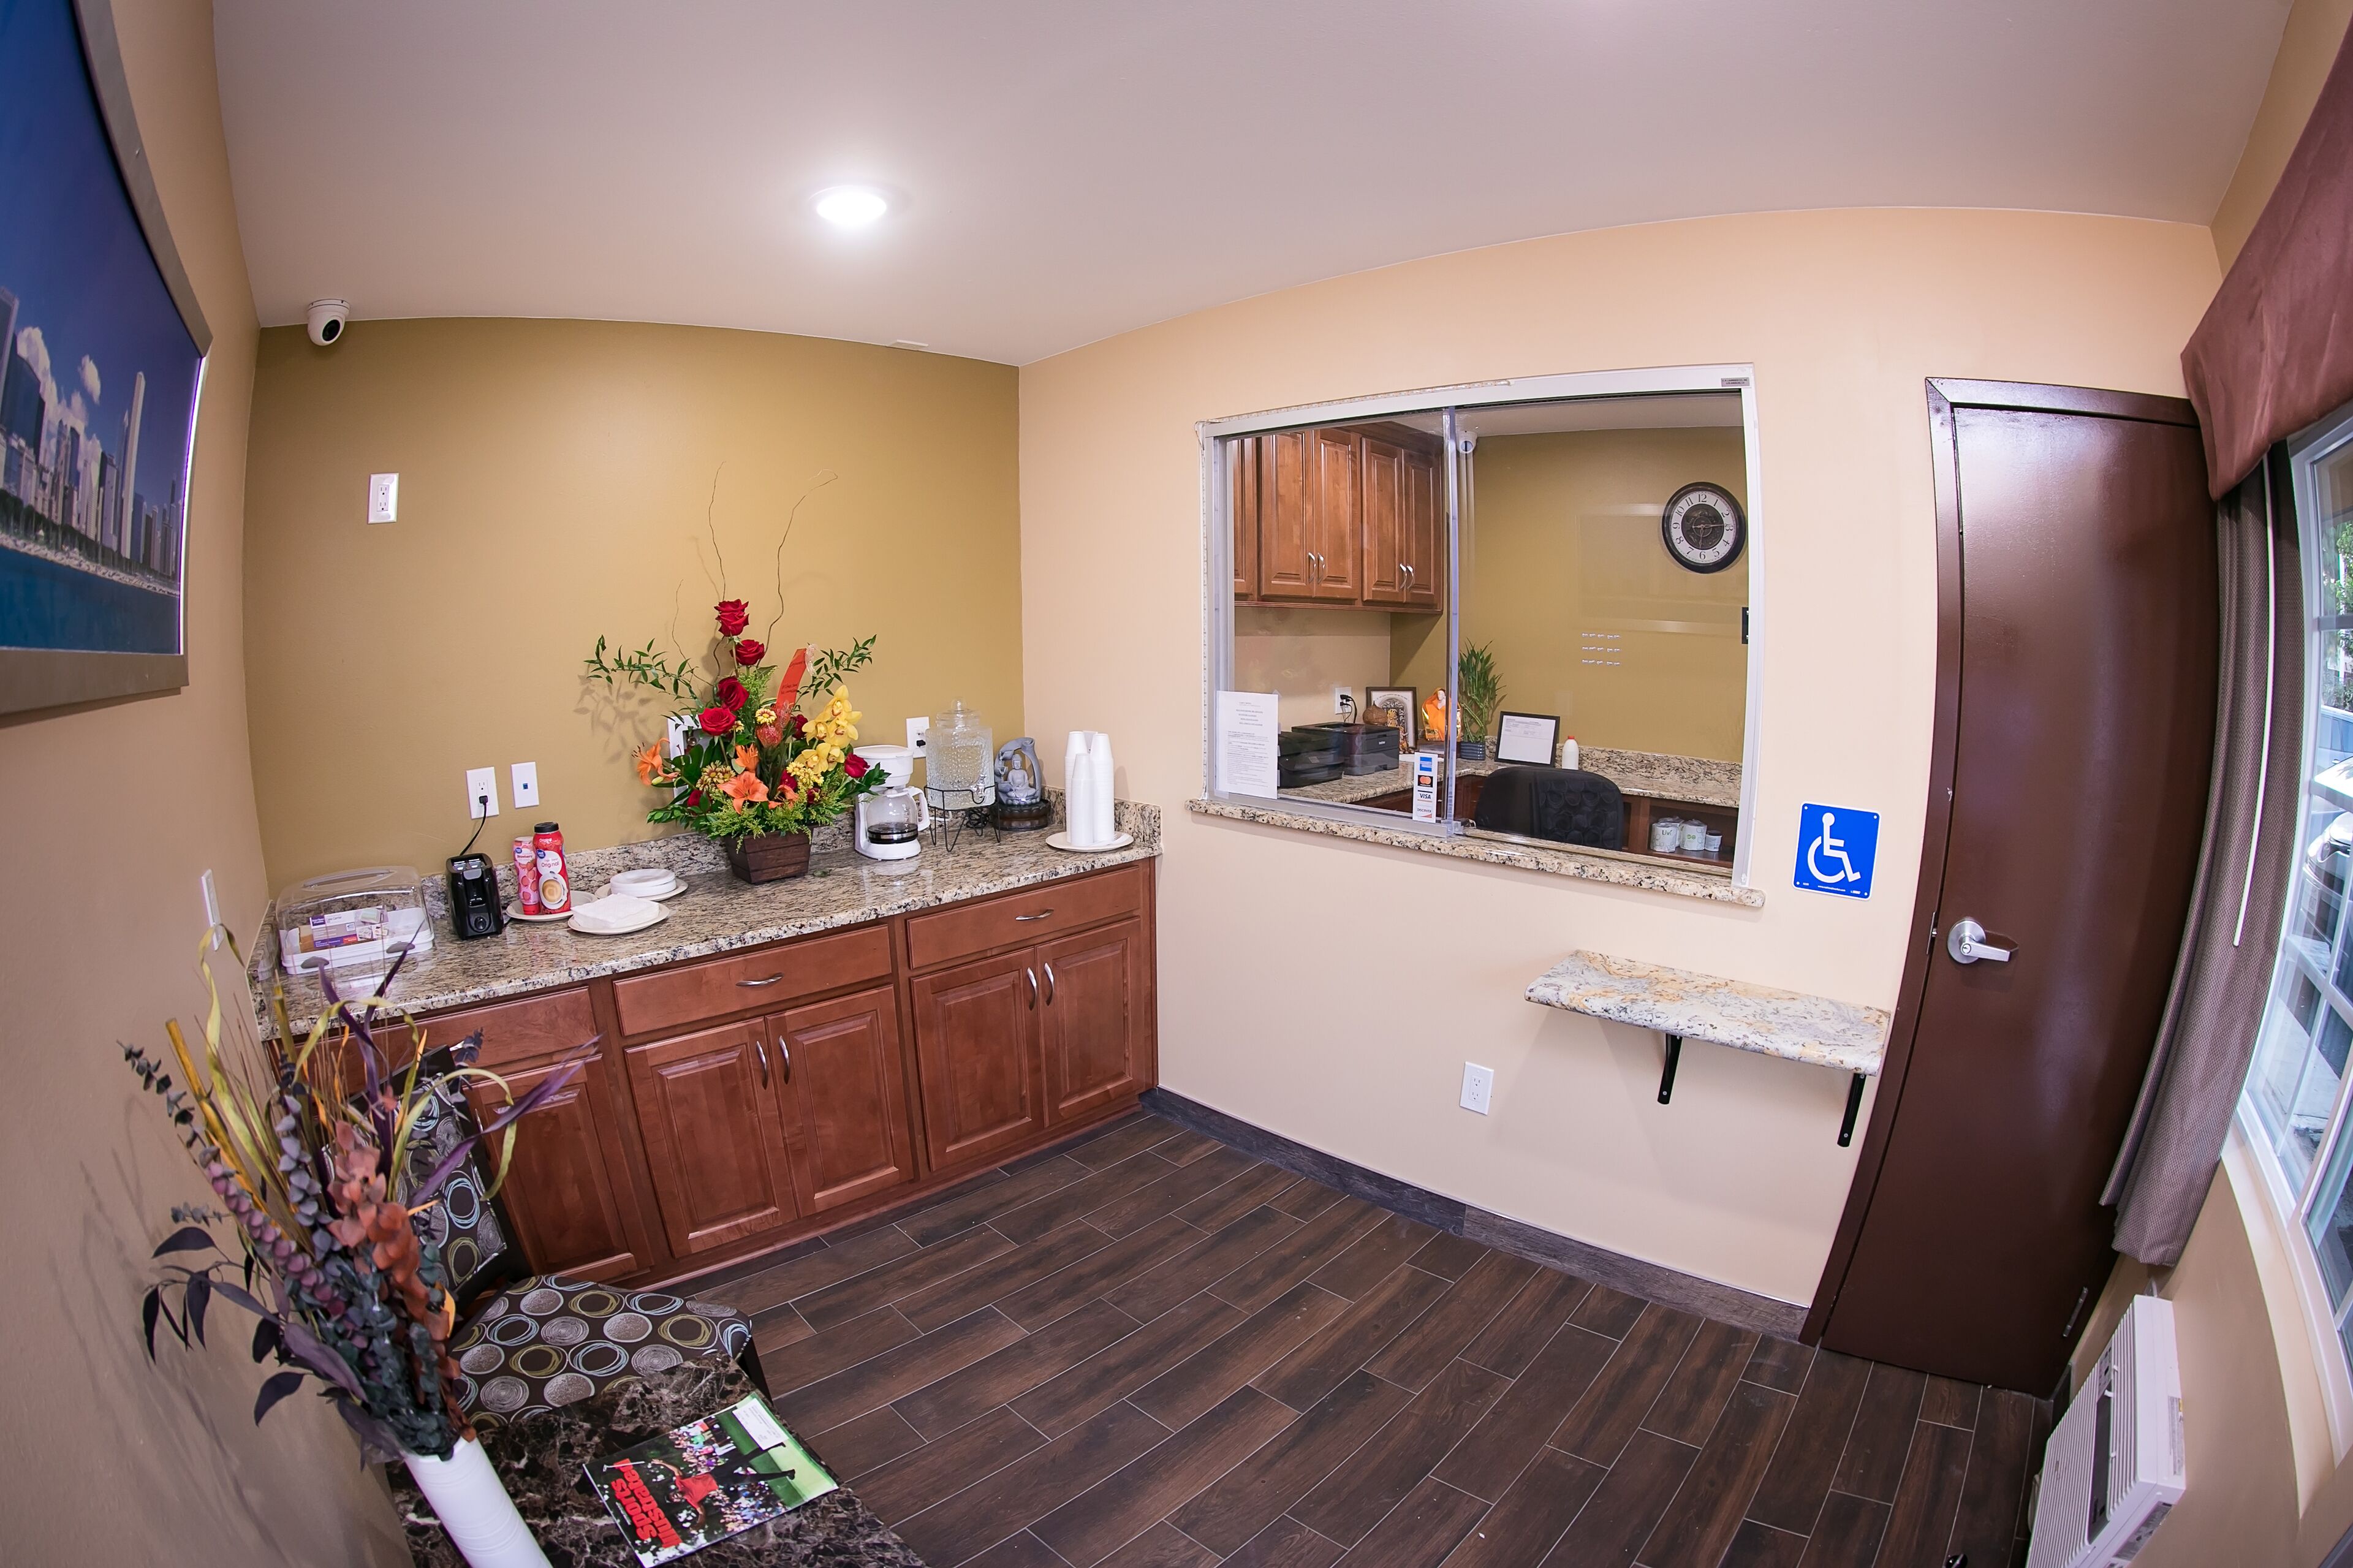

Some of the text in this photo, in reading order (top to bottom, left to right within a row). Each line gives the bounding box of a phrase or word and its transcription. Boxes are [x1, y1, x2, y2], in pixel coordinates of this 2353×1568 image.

[1685, 497, 1694, 506] 11
[1698, 494, 1707, 502] 12
[1675, 506, 1685, 517] 10
[1686, 547, 1694, 555] 7
[1699, 551, 1706, 560] 6
[1712, 548, 1720, 558] 5
[613, 1458, 683, 1548] Illustrated
[611, 1478, 657, 1540] Sports
